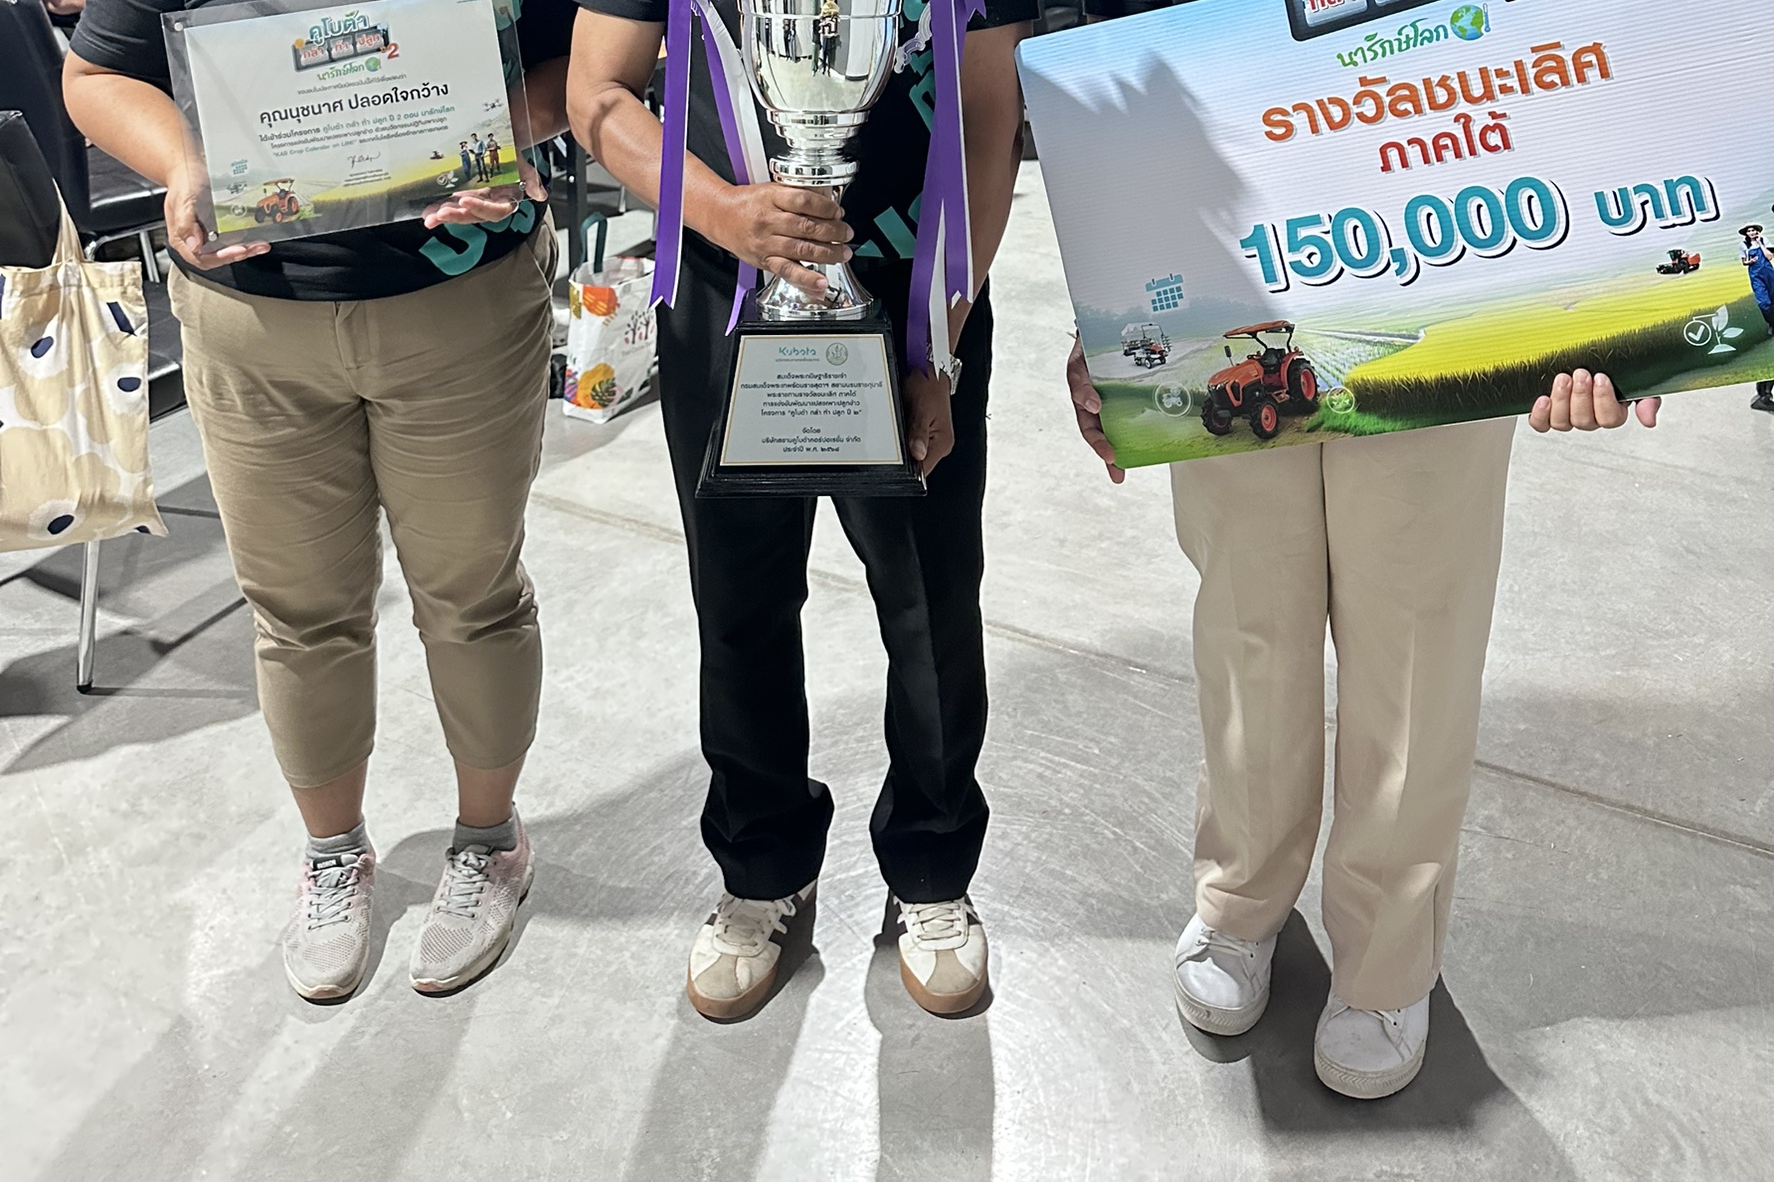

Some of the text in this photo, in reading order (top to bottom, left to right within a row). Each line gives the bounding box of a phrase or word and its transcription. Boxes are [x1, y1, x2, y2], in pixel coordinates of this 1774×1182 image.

[387, 42, 400, 60] 2
[1336, 17, 1449, 68] นารักษ์โลก
[259, 81, 449, 128] คุณนุชนาศ ปลอดใจกว้าง
[1261, 40, 1613, 143] รางวัลชนะเลิศ
[1378, 110, 1514, 173] ภาคใต้
[1239, 174, 1719, 293] 150,000 บาท
[779, 346, 817, 357] Kubota
